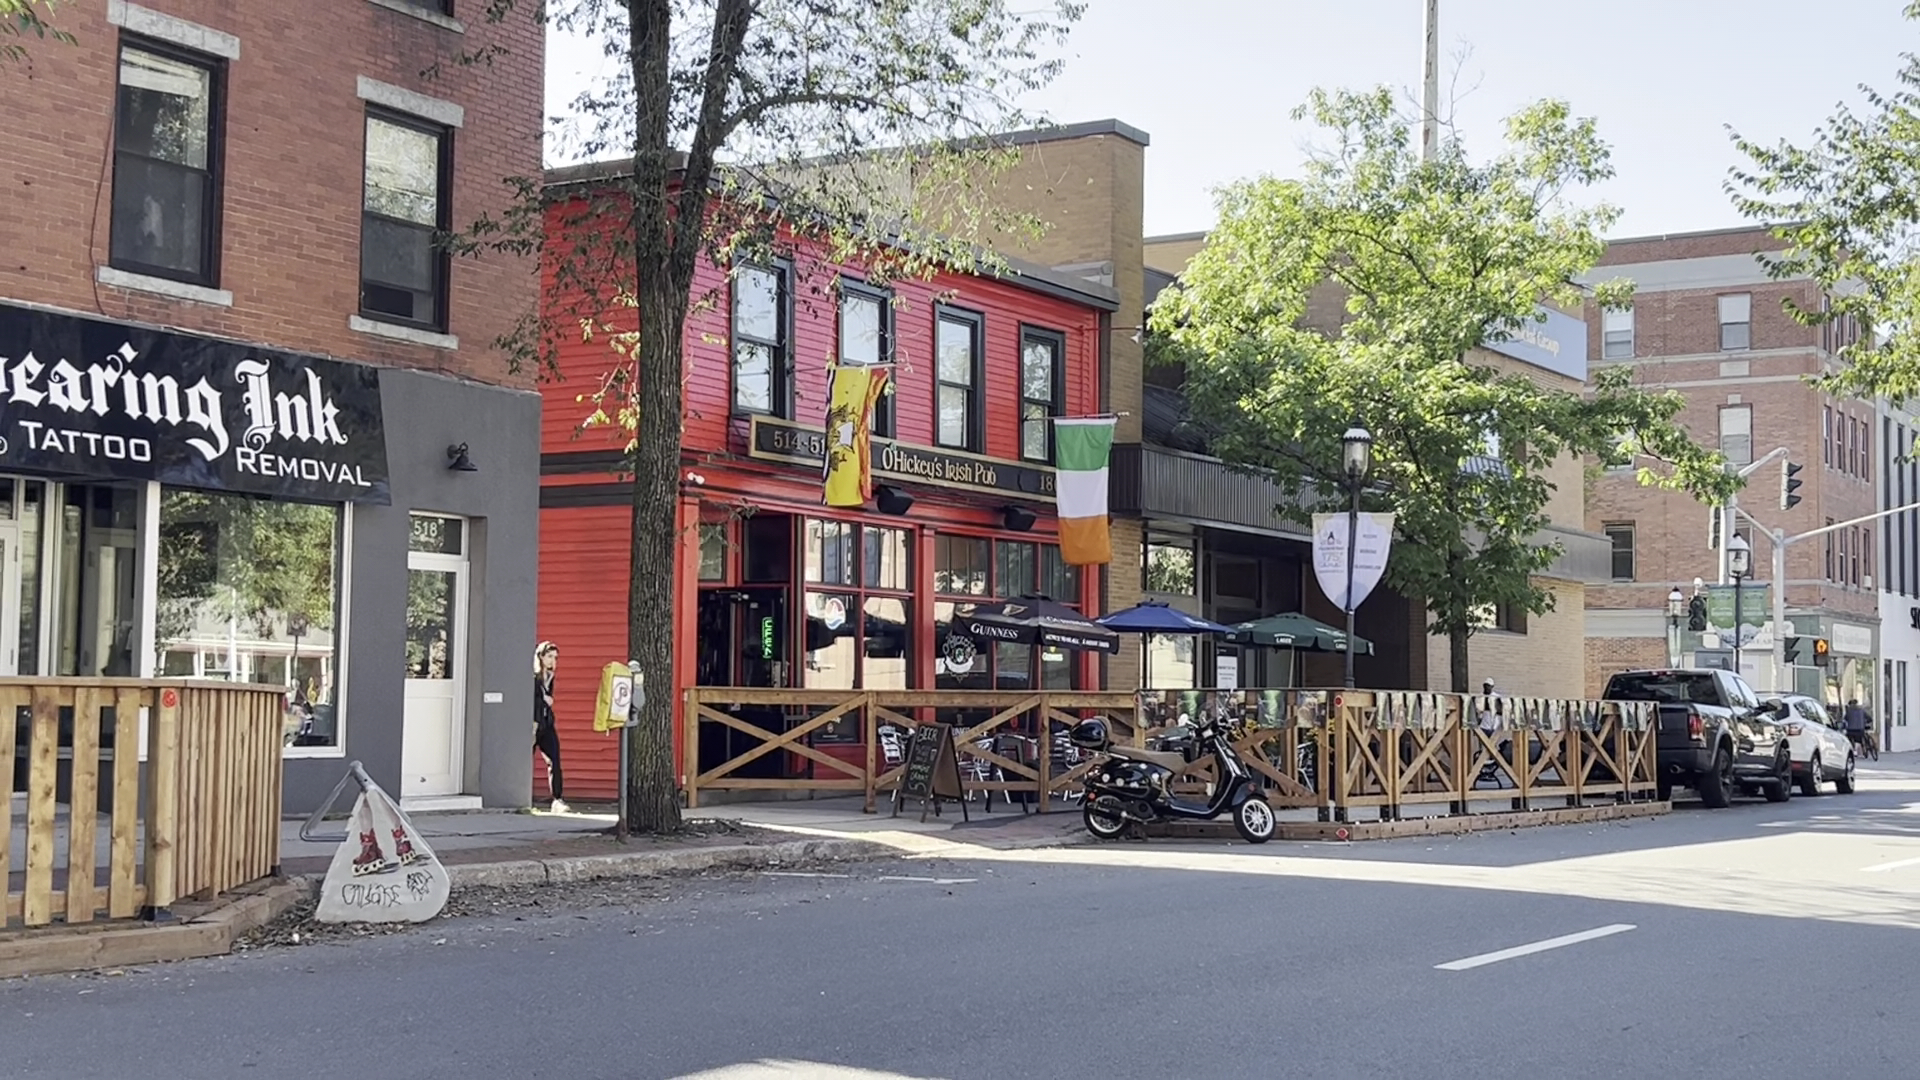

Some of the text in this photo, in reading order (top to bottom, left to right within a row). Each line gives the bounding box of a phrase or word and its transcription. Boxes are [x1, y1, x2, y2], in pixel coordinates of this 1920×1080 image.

[235, 358, 348, 453] Ink
[19, 420, 151, 462] TATTOO
[774, 430, 826, 455] 514-51
[237, 447, 371, 487] REMOVAL
[882, 445, 943, 481] O'Hickey's
[975, 462, 996, 485] Pub
[1040, 475, 1057, 492] 18
[413, 520, 438, 537] 518
[970, 623, 1019, 639] GUINNESS
